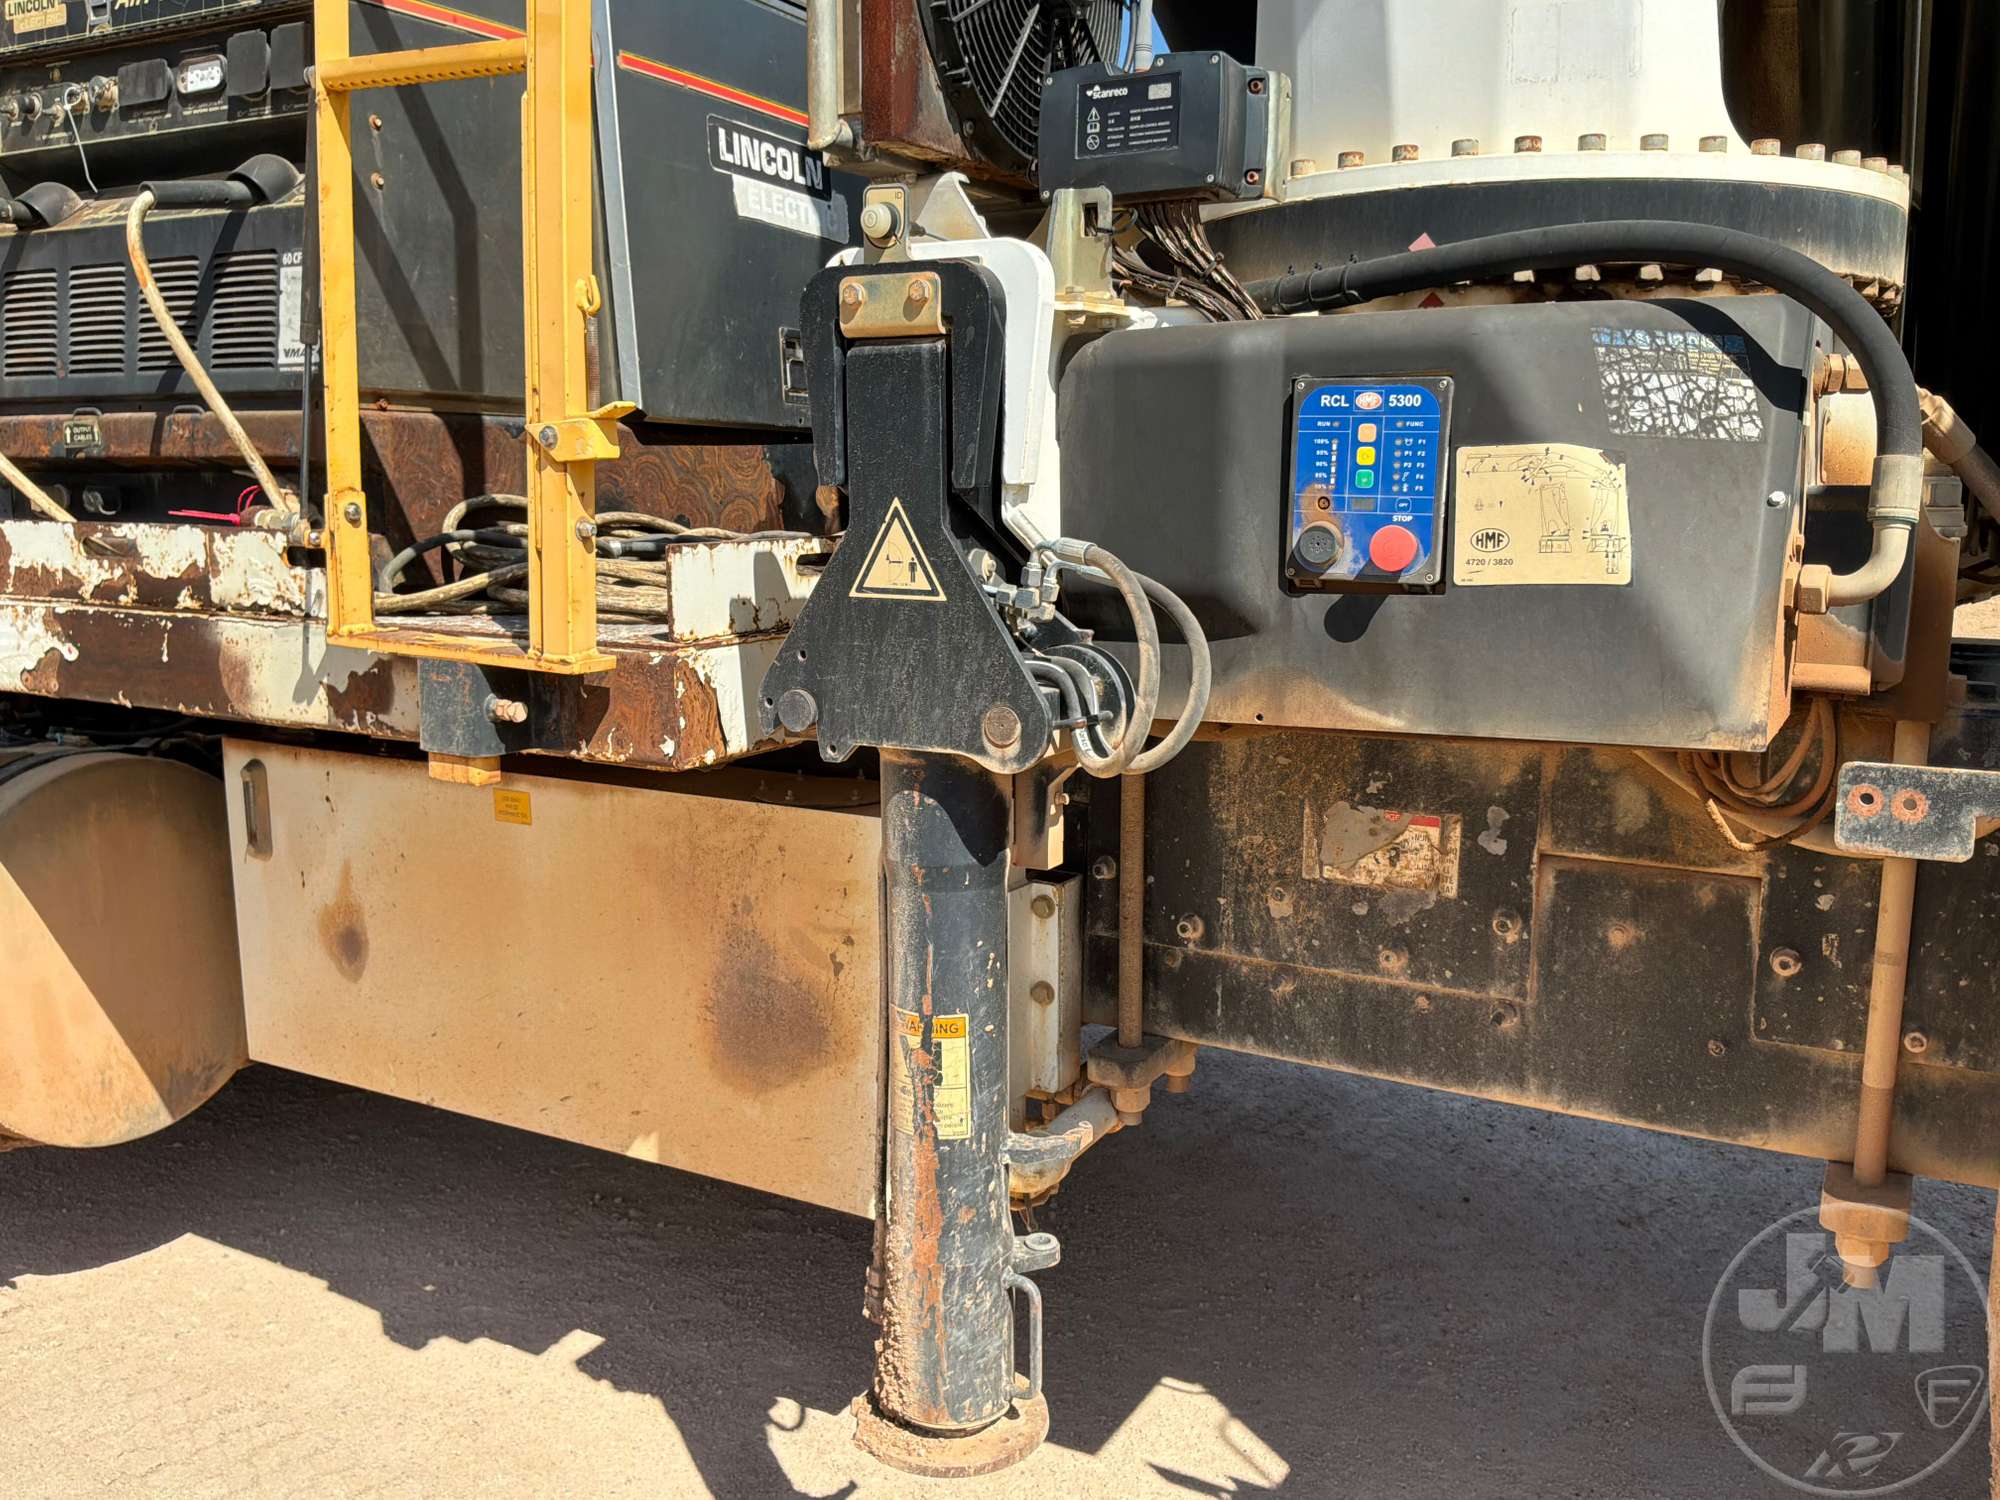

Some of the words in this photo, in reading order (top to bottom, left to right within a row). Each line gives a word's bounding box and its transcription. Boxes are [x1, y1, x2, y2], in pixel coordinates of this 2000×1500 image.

[8, 0, 56, 16] LINCOLN
[718, 126, 823, 190] LINCOLN
[1320, 395, 1349, 407] RCL
[1388, 394, 1421, 407] 5300
[1392, 514, 1413, 522] STOP
[1475, 531, 1505, 549] HMF
[1492, 558, 1514, 566] 3820
